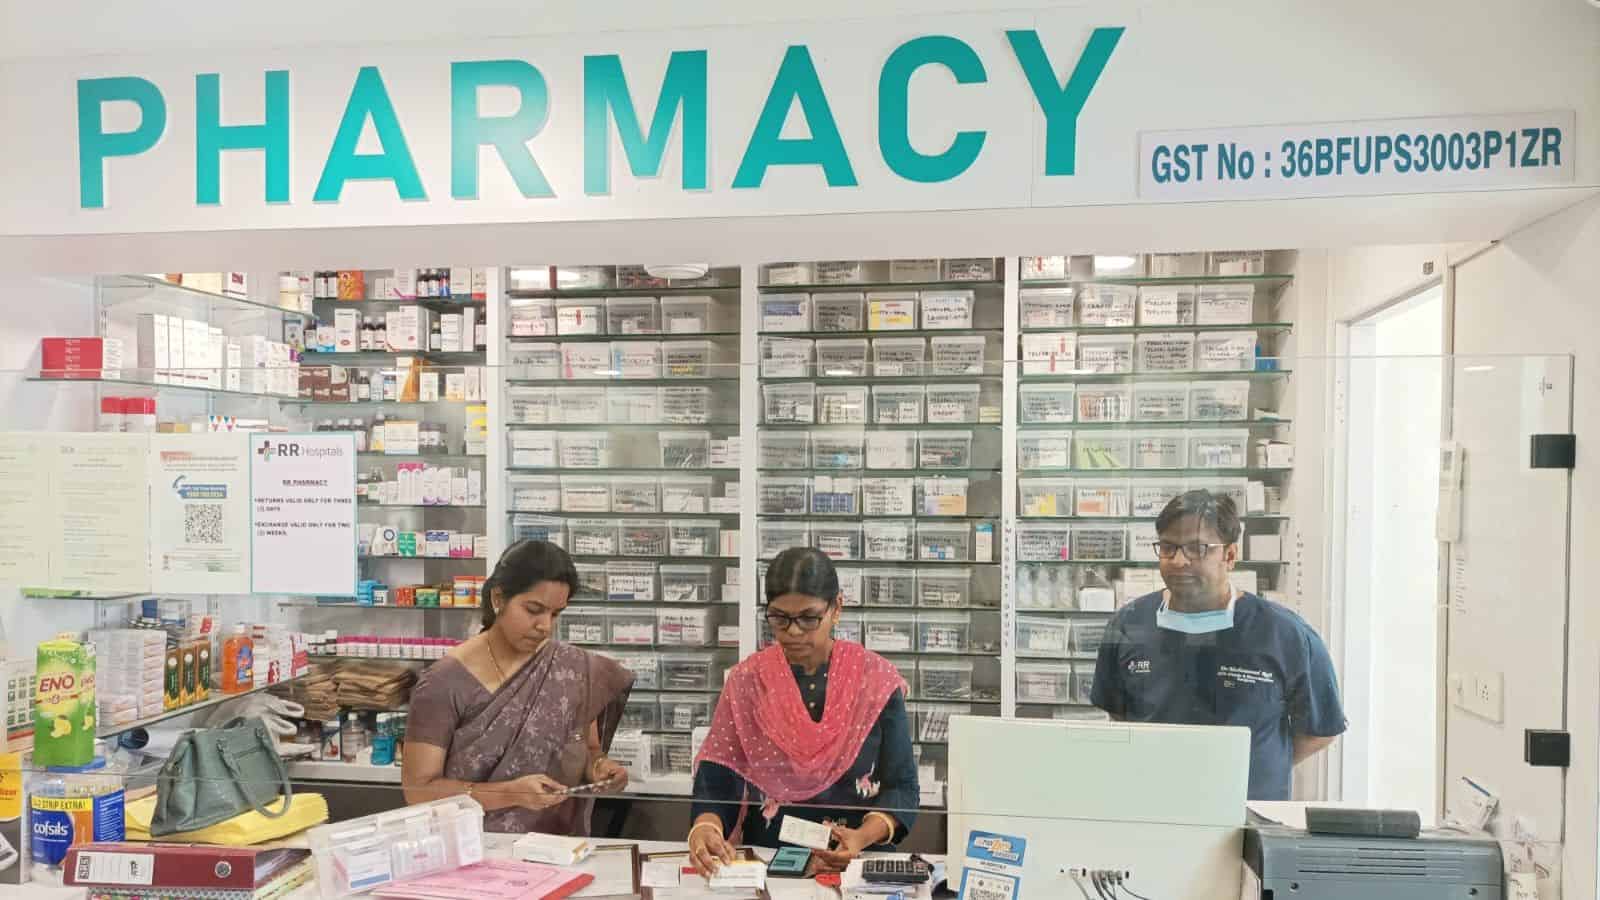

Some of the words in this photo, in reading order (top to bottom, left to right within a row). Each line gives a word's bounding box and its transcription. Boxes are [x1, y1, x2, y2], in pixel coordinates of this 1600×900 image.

[77, 26, 1126, 209] PHARMACY
[1151, 143, 1209, 184] GST
[1217, 143, 1256, 181] No
[1281, 127, 1563, 179] 36BFUPS3003P1ZR
[277, 443, 300, 457] RR
[301, 446, 344, 460] Hospitals
[291, 479, 328, 487] PHARMACY
[39, 674, 74, 692] ENO
[42, 799, 59, 809] STRIP
[33, 820, 69, 836] cofsils
